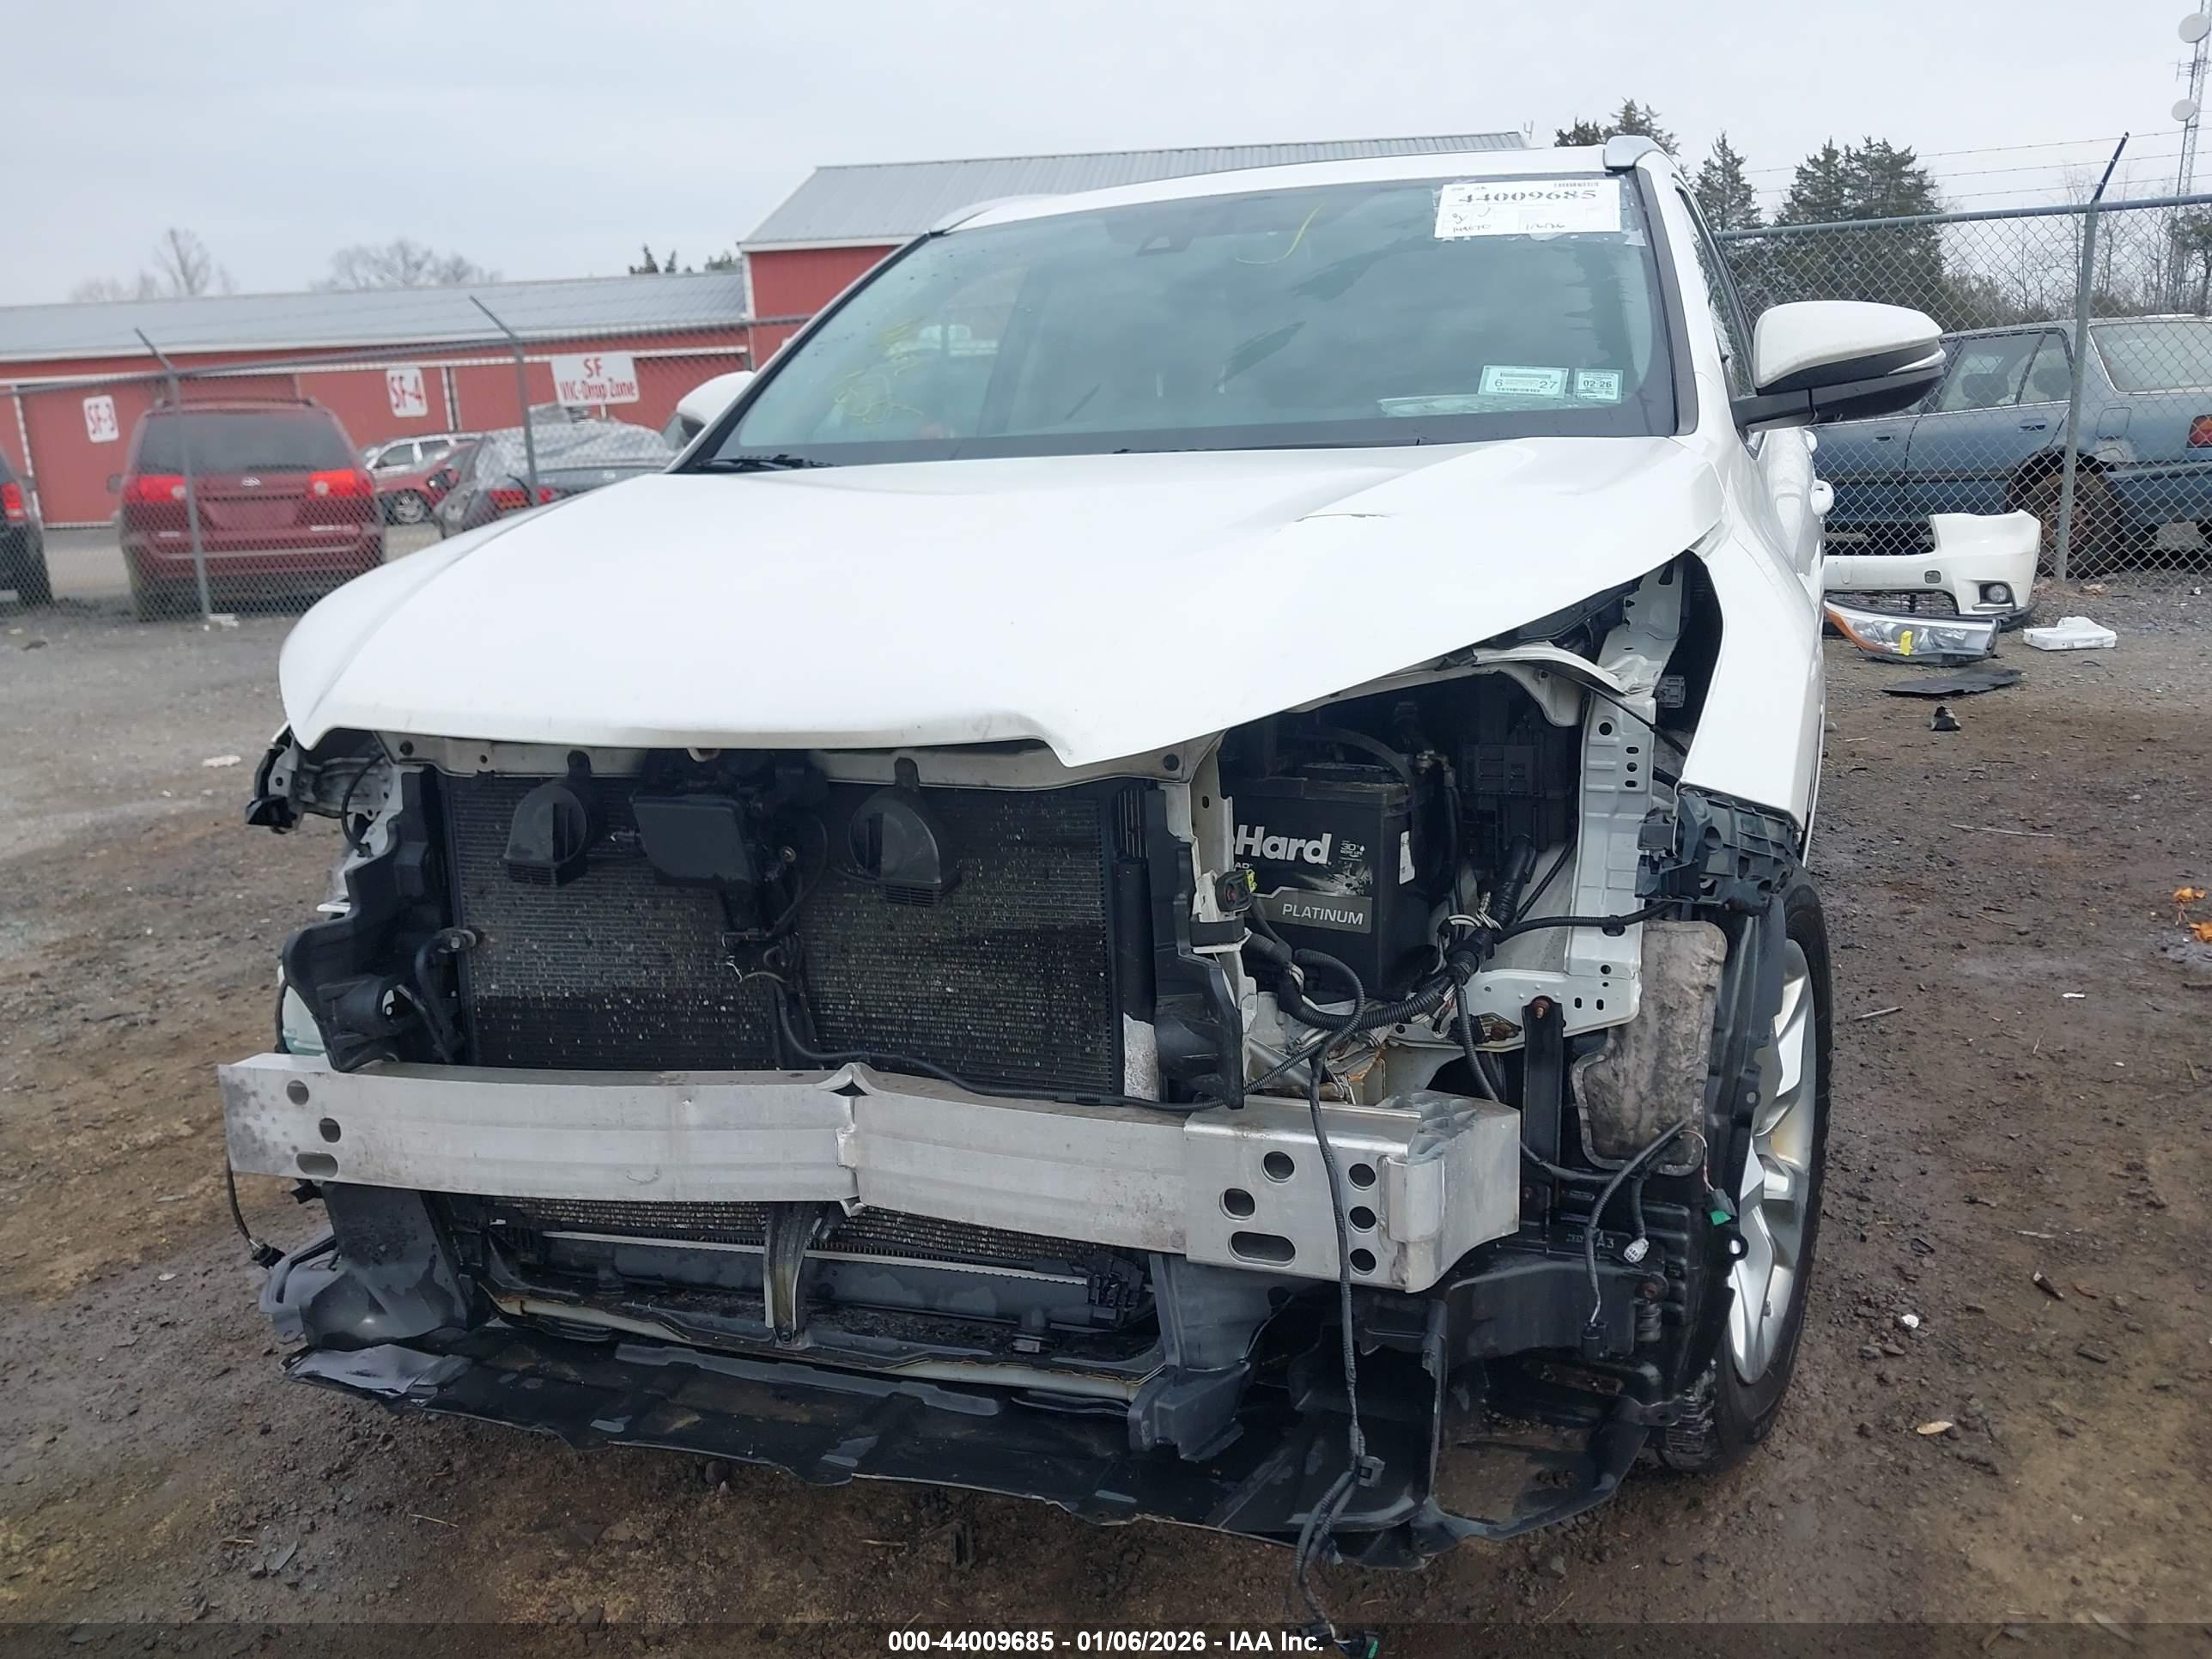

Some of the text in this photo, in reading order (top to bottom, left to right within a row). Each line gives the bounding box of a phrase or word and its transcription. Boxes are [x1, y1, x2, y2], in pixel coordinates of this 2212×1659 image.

[1458, 190, 1597, 204] 44009685
[584, 357, 602, 379] SF
[391, 375, 423, 408] SF-4
[1539, 380, 1558, 390] 27
[1235, 824, 1332, 866] Hard
[1282, 903, 1364, 926] PLATINUM
